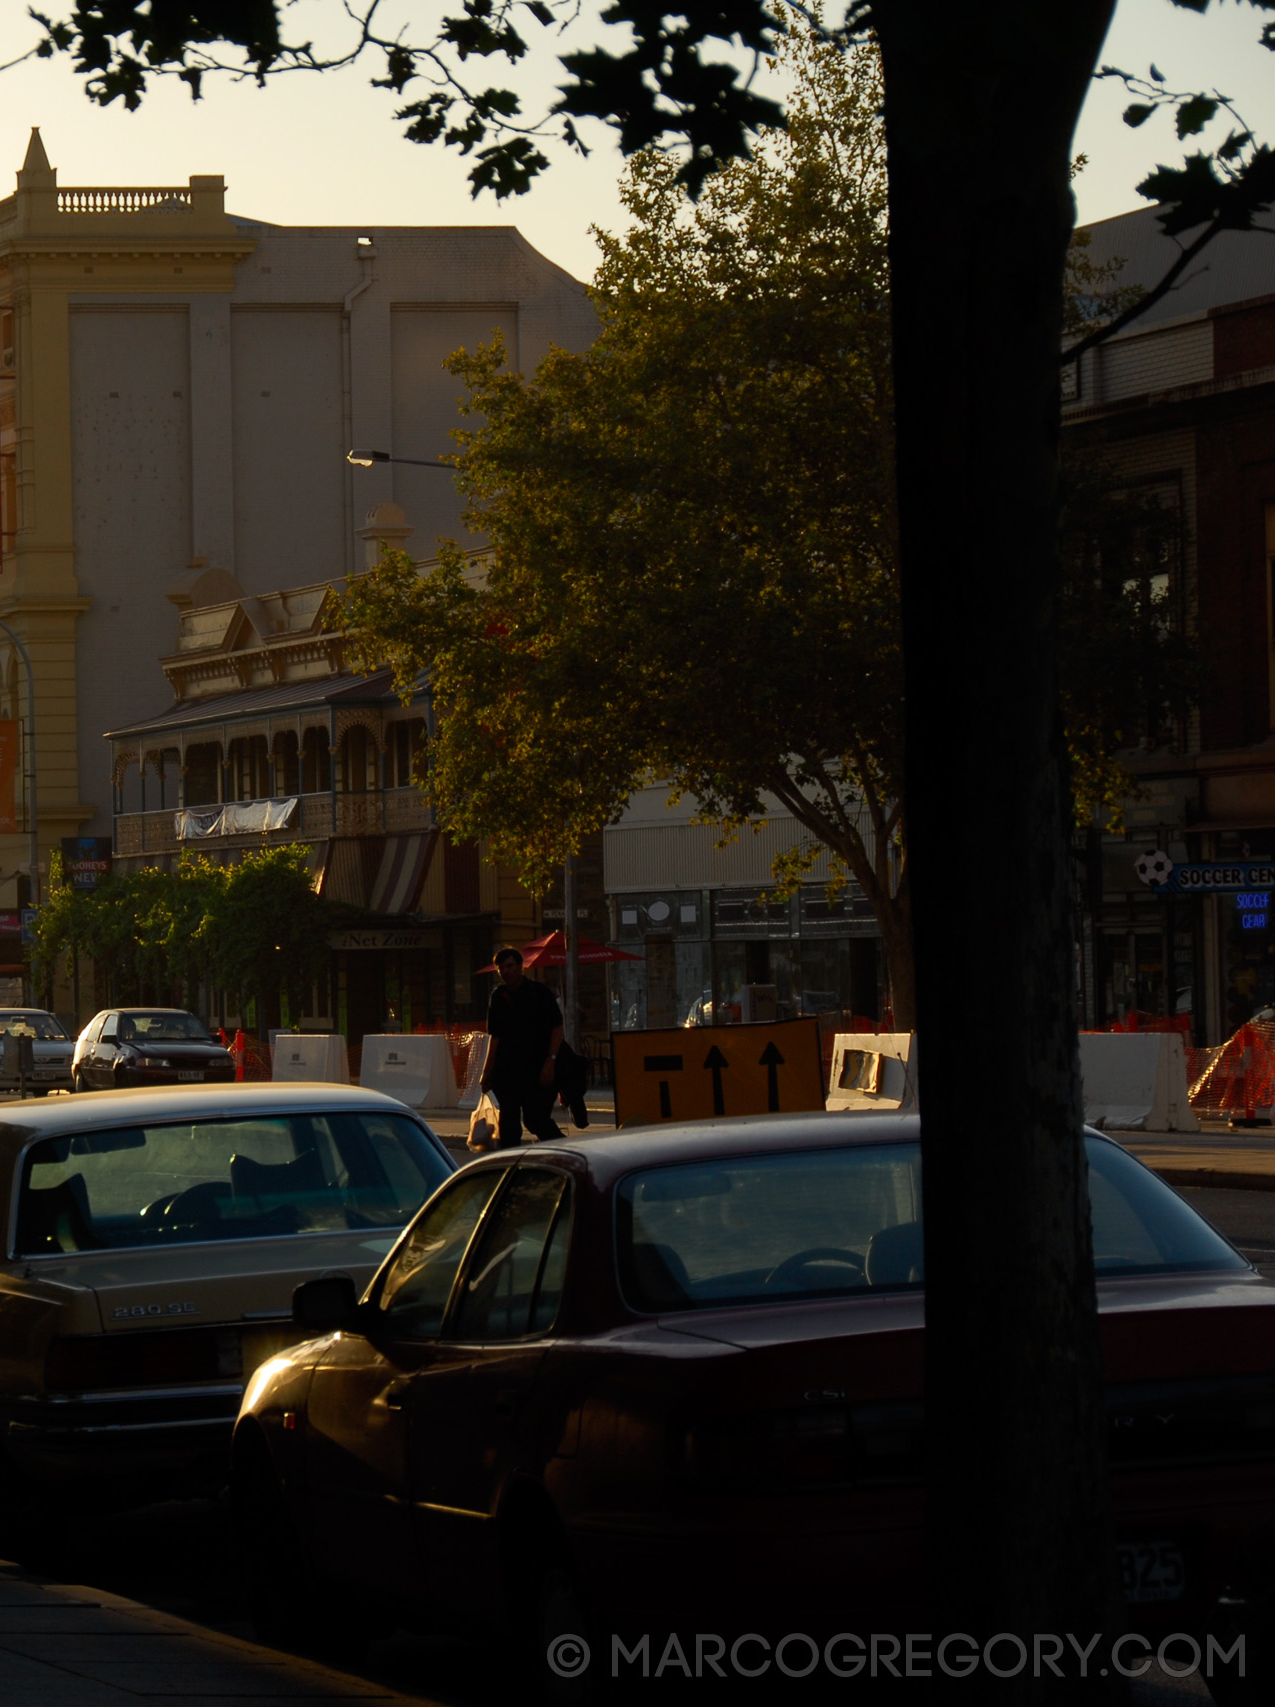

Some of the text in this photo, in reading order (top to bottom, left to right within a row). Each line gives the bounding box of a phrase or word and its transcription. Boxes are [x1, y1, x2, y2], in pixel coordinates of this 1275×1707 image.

[1179, 868, 1244, 886] SOCCER
[381, 932, 422, 947] Zone
[114, 1303, 198, 1318] 280 SE
